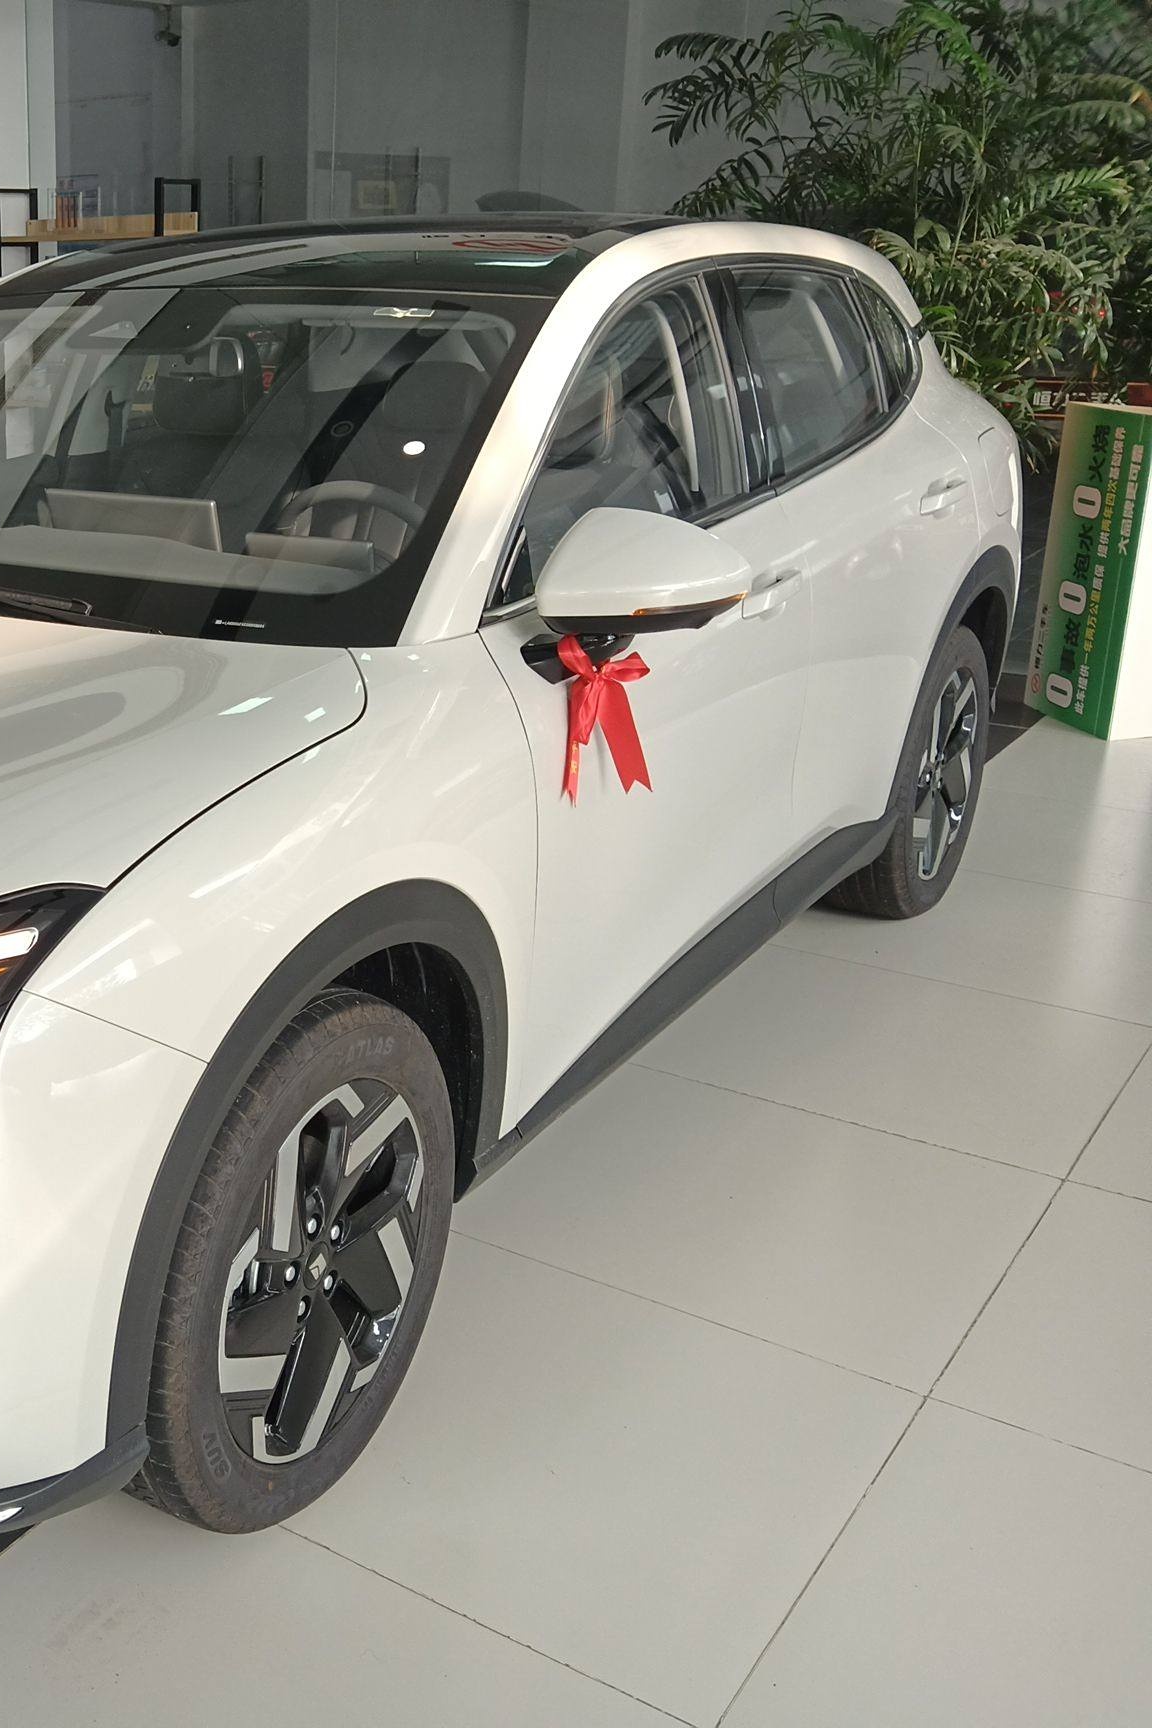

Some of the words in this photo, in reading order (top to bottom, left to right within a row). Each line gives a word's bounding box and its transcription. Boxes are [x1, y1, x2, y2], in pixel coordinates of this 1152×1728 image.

[1118, 445, 1144, 556] 大品牌更可靠
